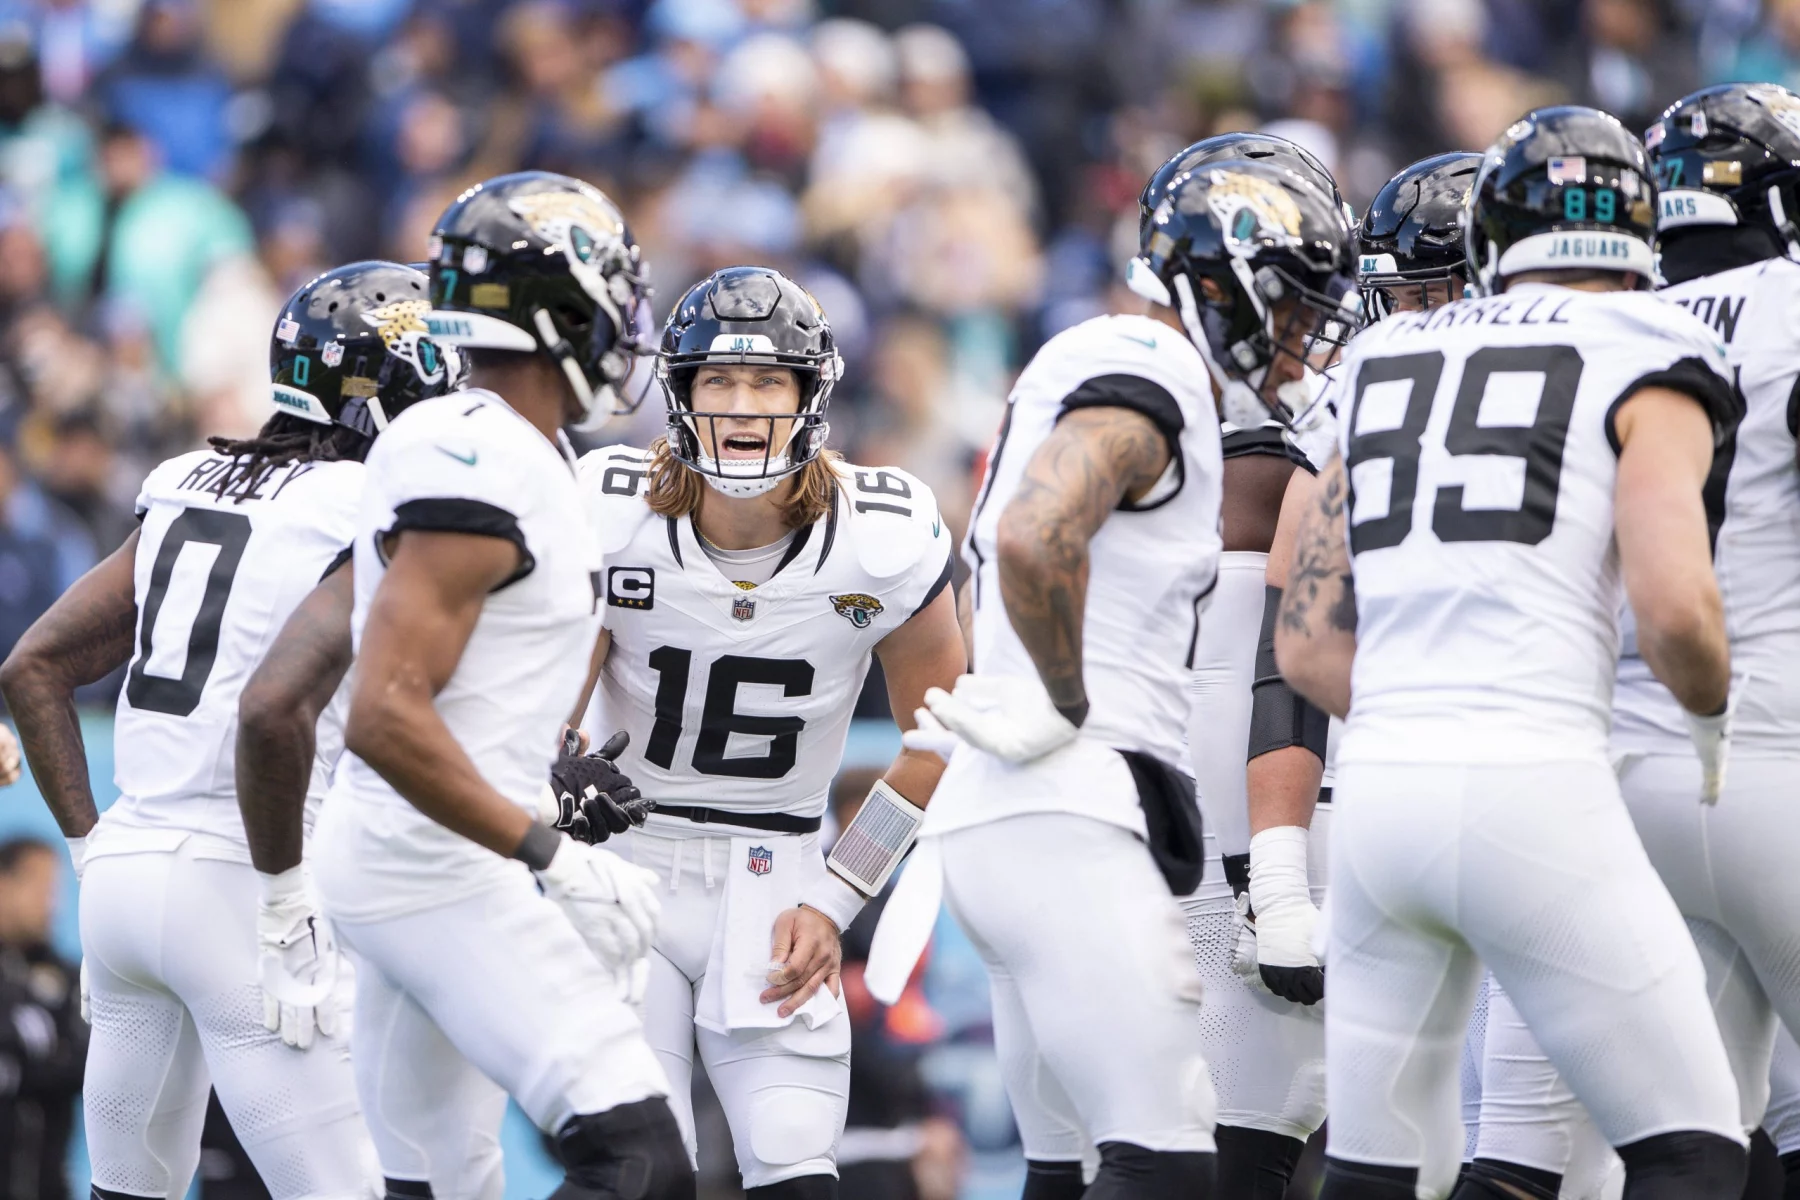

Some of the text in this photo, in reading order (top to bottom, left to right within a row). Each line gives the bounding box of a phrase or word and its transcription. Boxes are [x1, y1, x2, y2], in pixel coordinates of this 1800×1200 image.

[1564, 187, 1616, 223] 89
[1547, 238, 1630, 260] JAGUARS
[440, 268, 458, 304] 7
[1676, 295, 1746, 343] ON
[730, 337, 754, 351] JAX
[293, 354, 310, 387] 0
[1347, 344, 1584, 558] 89
[854, 471, 913, 518] 16
[611, 569, 652, 600] C
[126, 506, 252, 717] 0
[735, 607, 752, 620] NFL
[644, 644, 816, 779] 16
[750, 856, 770, 873] NFL
